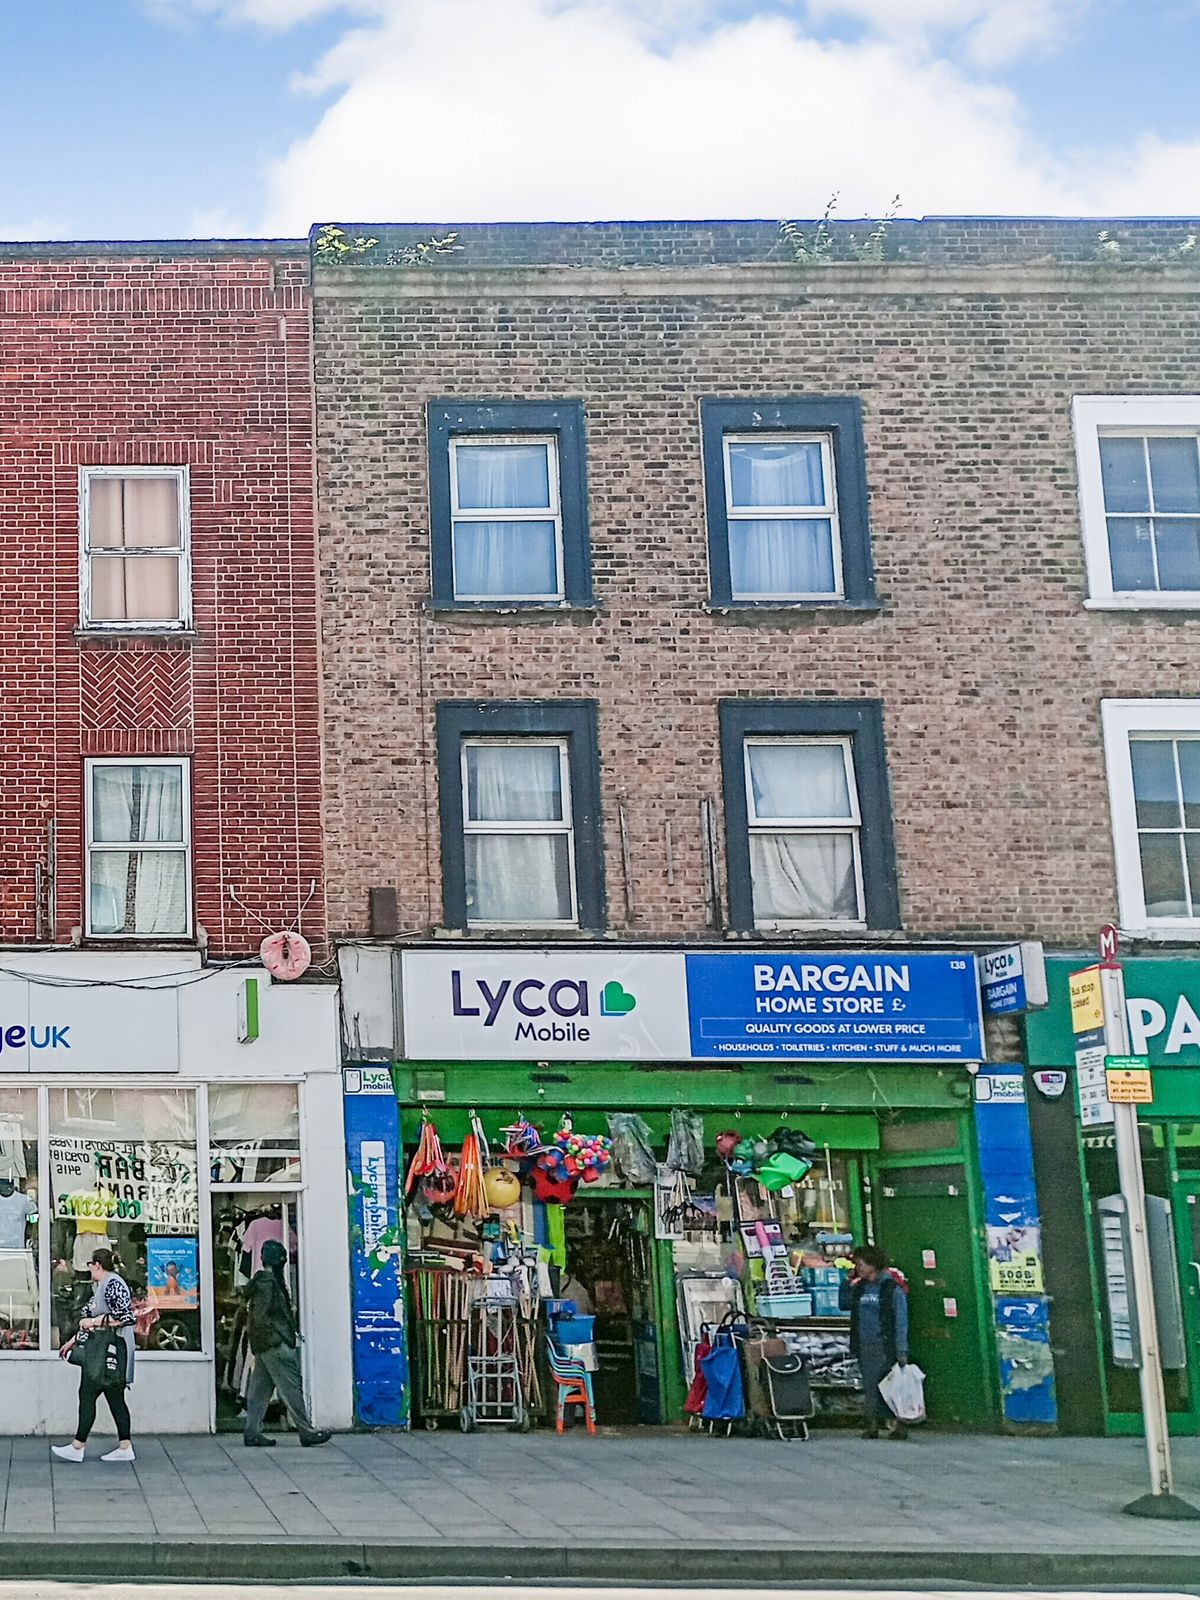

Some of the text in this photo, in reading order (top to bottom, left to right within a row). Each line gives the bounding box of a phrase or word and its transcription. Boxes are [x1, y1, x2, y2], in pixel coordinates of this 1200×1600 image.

[1100, 930, 1115, 958] M
[949, 960, 966, 970] 138
[984, 955, 1007, 976] Lyca
[753, 964, 910, 993] BARGAIN
[986, 982, 1018, 1000] BARGAIN
[1081, 983, 1095, 993] stop
[451, 970, 590, 1027] Lyca
[756, 997, 815, 1014] HOME
[822, 996, 885, 1014] STORE
[514, 1022, 591, 1042] Mobile
[745, 1023, 926, 1034] QUALITY GOODS AT LOWER PRICE
[718, 1043, 961, 1053] HOUSEHOLDS TOILETRIES KITCHEN STUFF & MUCH MORE
